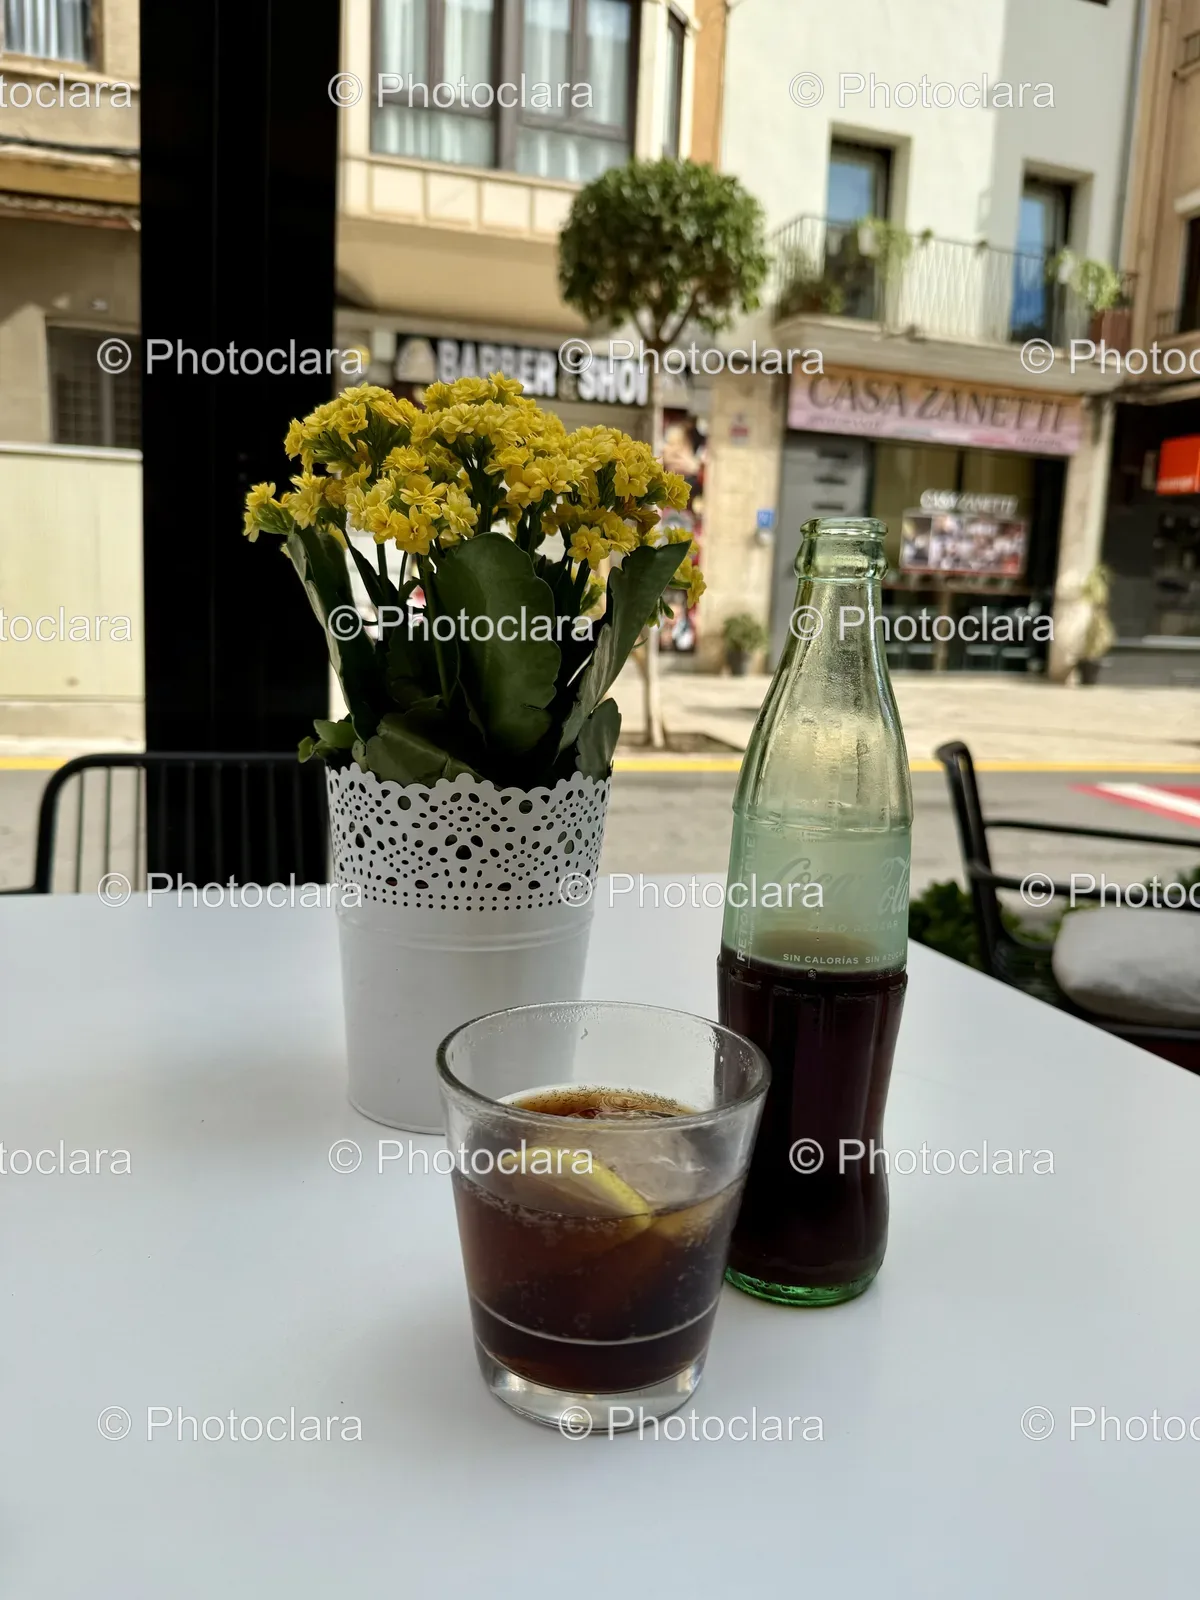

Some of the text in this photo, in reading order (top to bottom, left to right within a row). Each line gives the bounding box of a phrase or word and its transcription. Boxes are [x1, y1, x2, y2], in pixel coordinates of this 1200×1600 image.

[808, 373, 1067, 435] CASA ZANETTI
[783, 953, 801, 963] SIN
[804, 955, 859, 965] CALORÍAS
[865, 956, 880, 964] SIN
